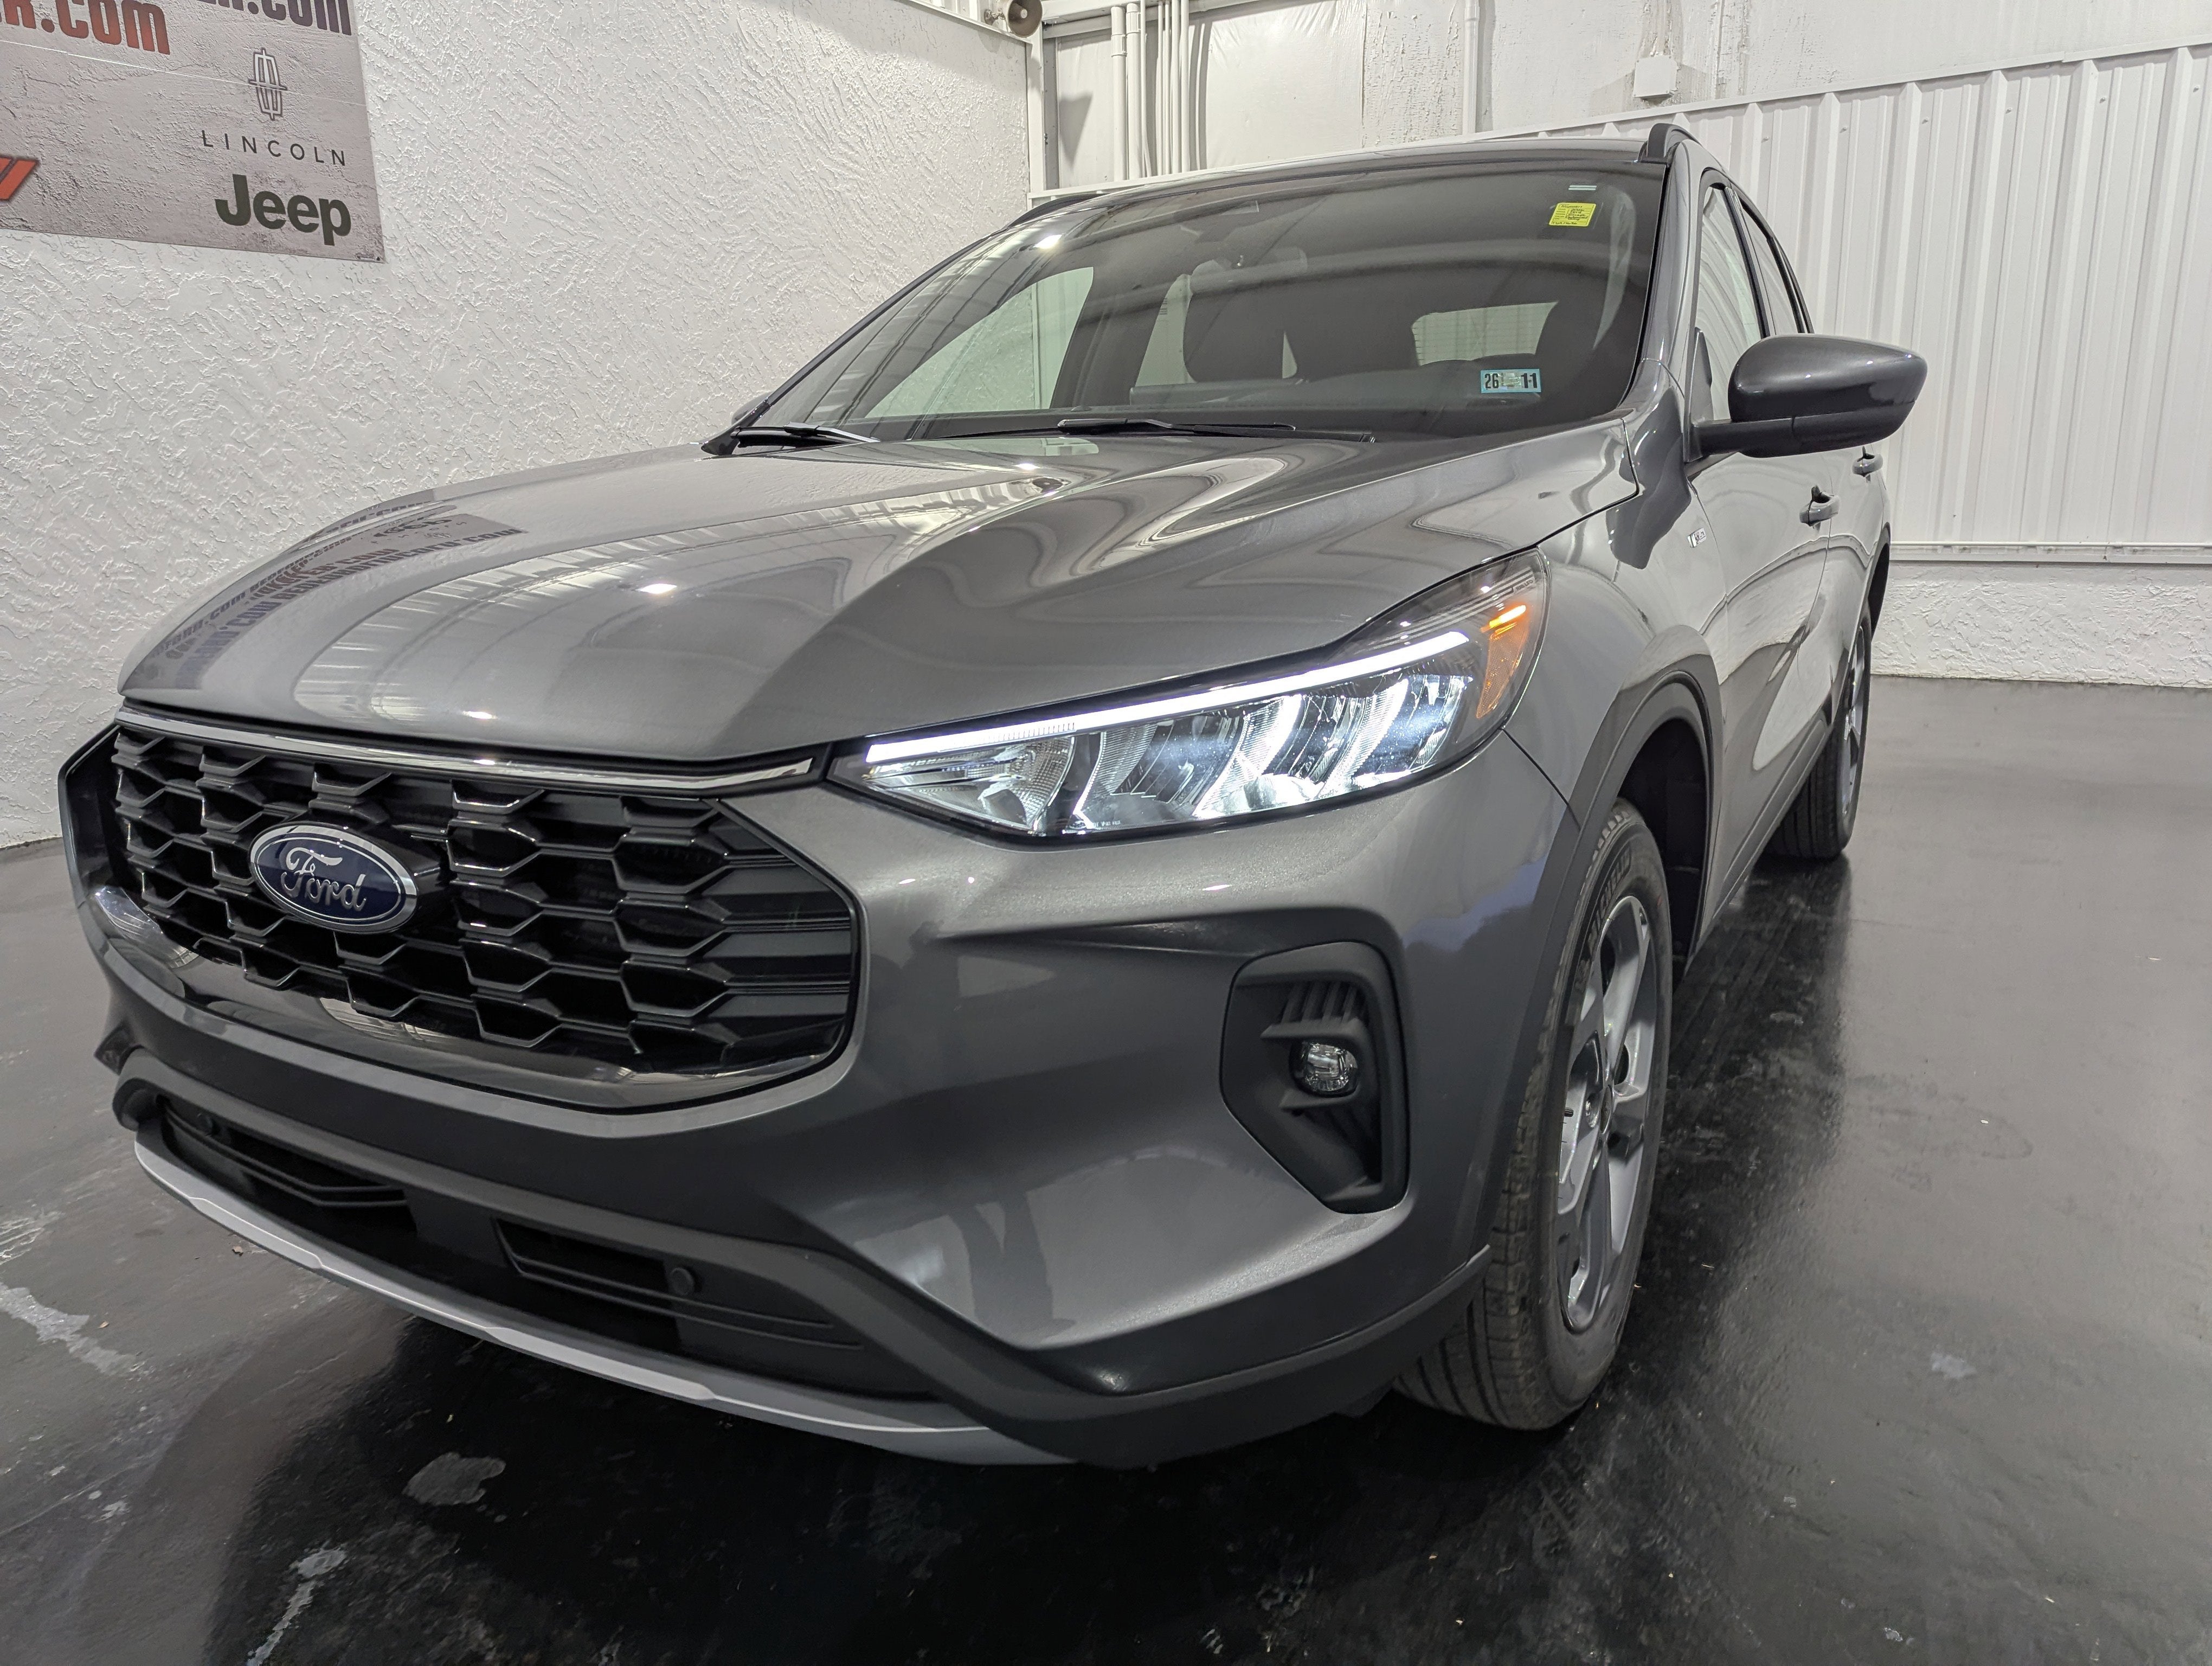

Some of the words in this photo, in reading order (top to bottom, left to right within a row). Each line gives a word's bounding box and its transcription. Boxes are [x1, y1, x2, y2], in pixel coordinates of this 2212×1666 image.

[202, 130, 345, 166] LINCOLN
[215, 174, 351, 246] Jeep
[1484, 373, 1499, 389] 26
[1520, 373, 1538, 389] 11
[280, 847, 366, 911] Ford
